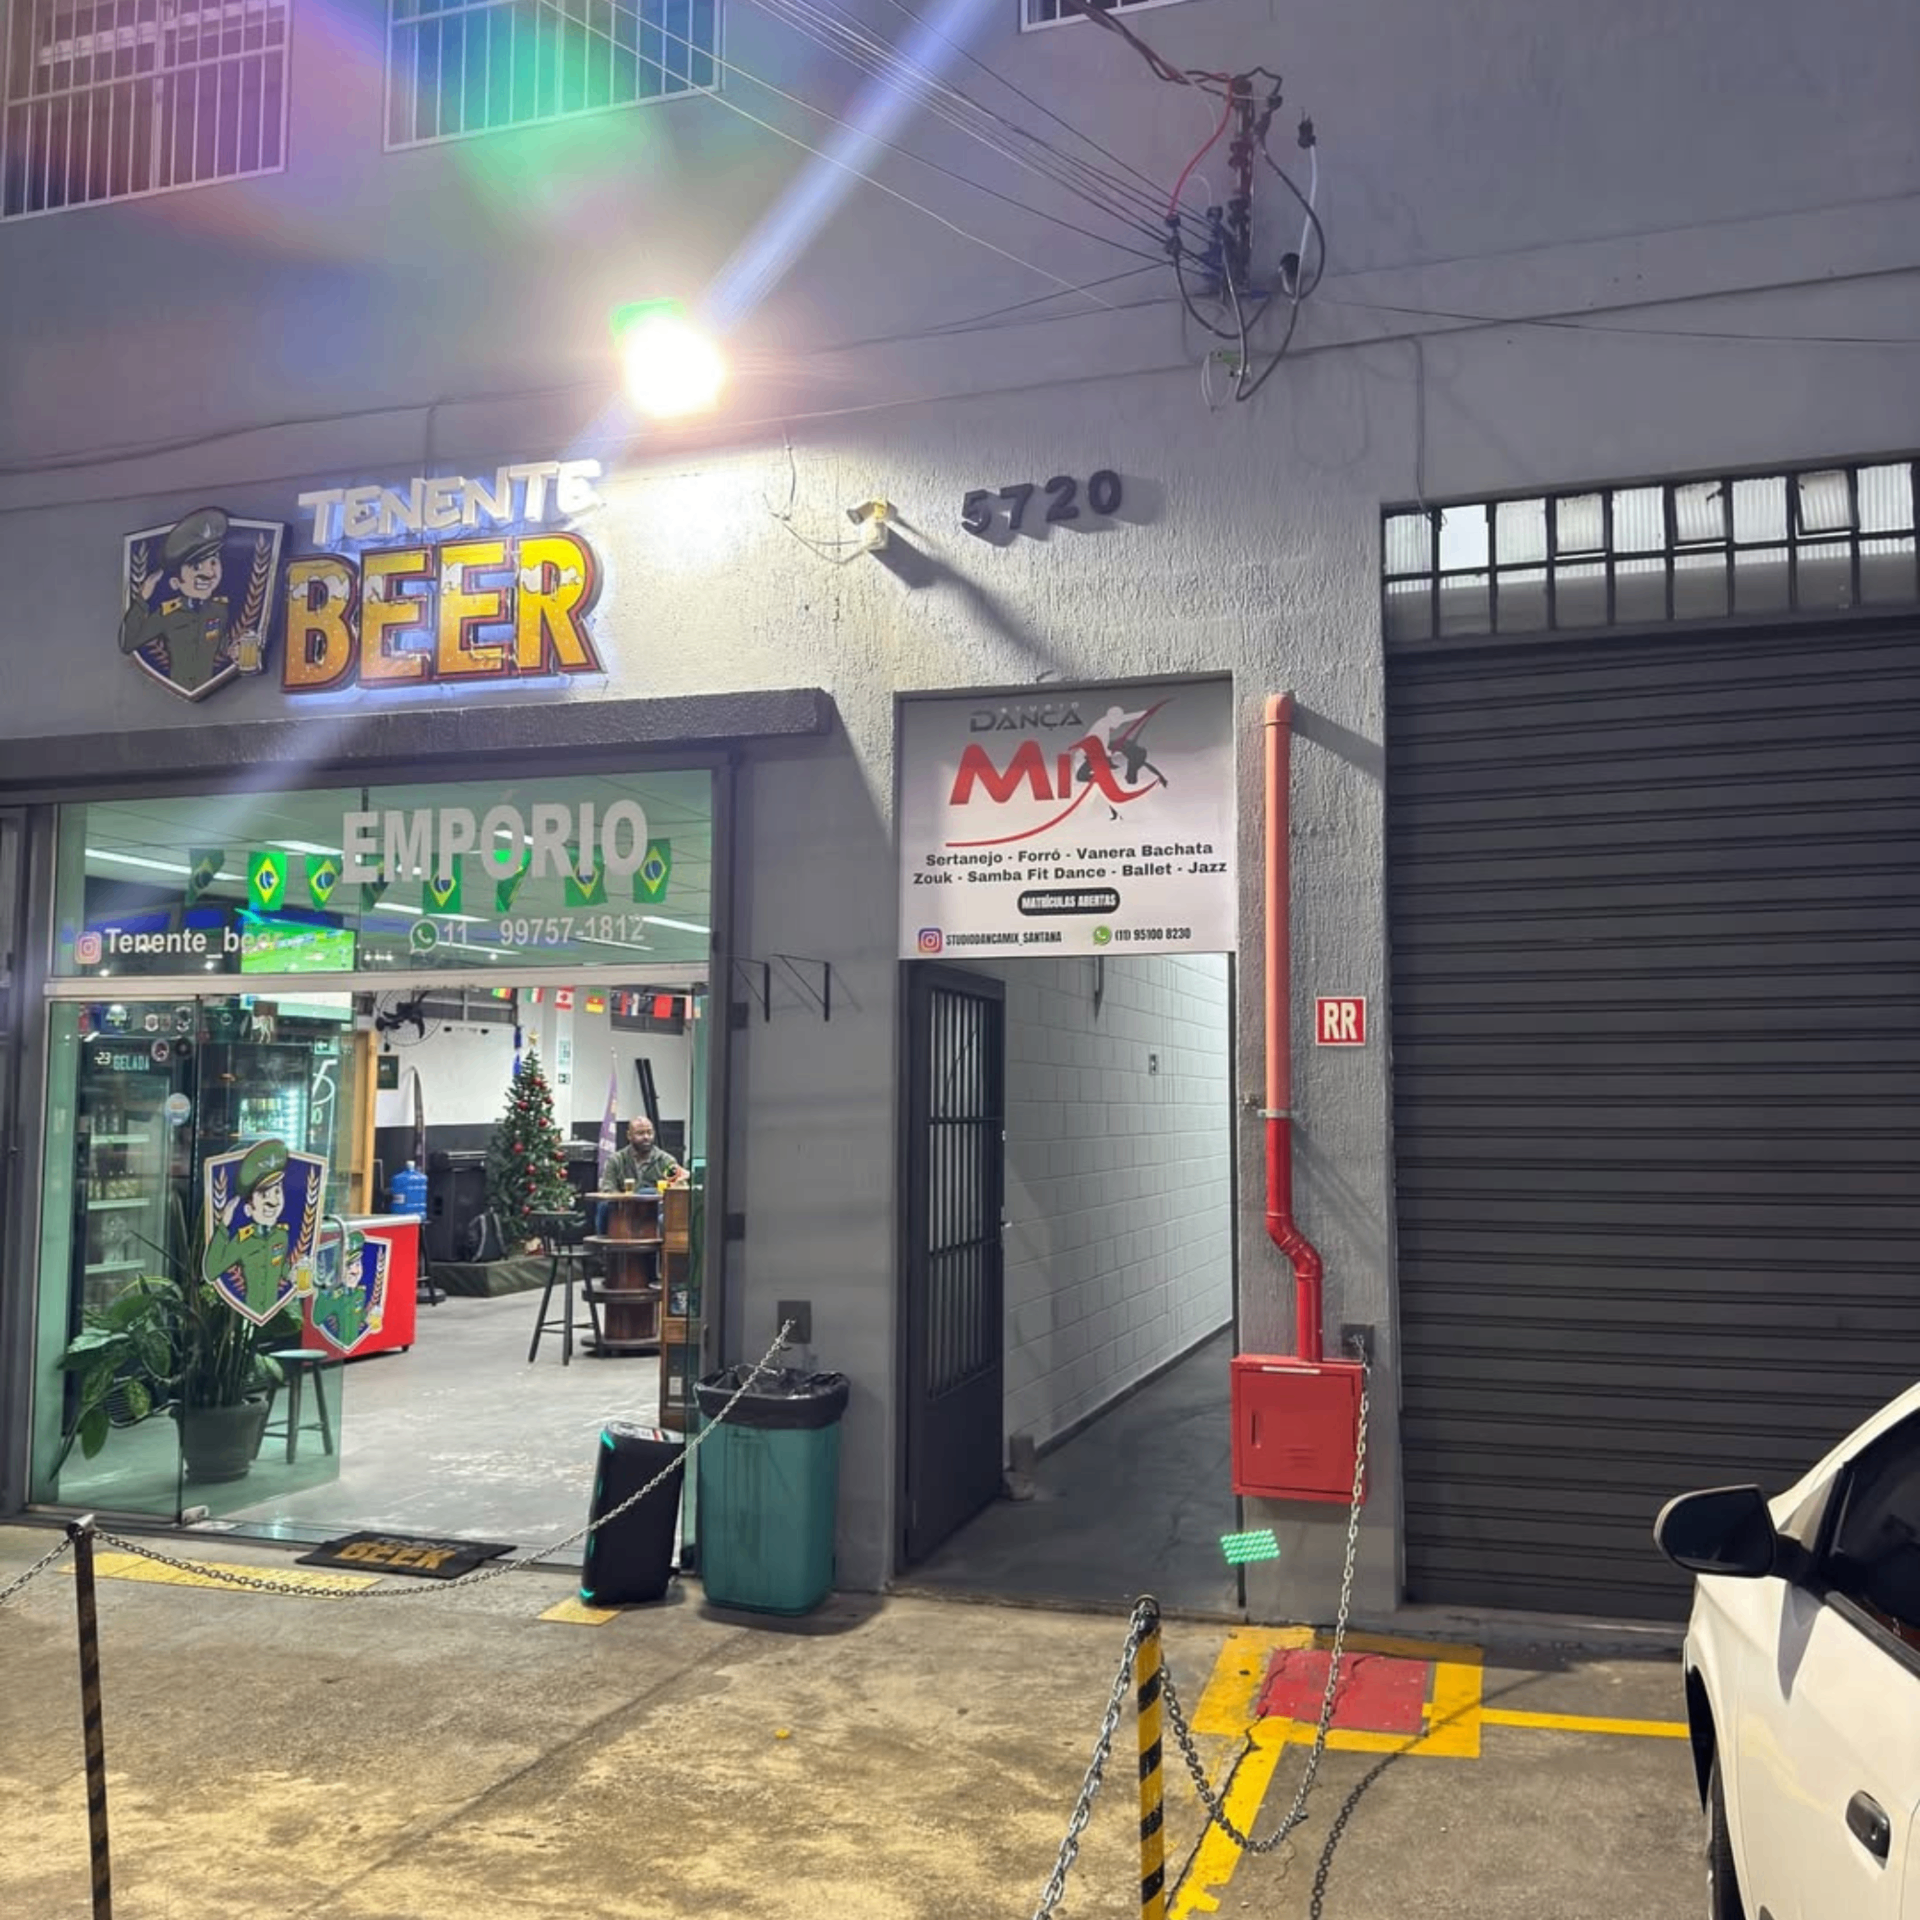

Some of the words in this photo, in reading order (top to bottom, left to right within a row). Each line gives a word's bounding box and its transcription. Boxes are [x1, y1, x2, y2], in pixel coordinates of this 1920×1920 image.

[299, 459, 602, 546] TENENTE
[961, 469, 1122, 535] 5720
[281, 532, 608, 693] BEER
[970, 709, 1084, 732] DANÇA
[926, 851, 1003, 867] Sertanejo
[1018, 848, 1061, 862] Forró
[1077, 847, 1136, 860] Vanera
[1142, 843, 1213, 857] Bachata
[913, 872, 953, 885] Zouk
[967, 869, 1022, 883] Samba
[1027, 867, 1049, 880] Fit
[1054, 867, 1106, 880] Dance
[1122, 863, 1172, 877] Ballet
[1188, 861, 1227, 874] Jazz
[105, 926, 284, 959] Tenente_beer
[443, 921, 468, 945] 11
[500, 914, 646, 945] 99757-1812
[1323, 1002, 1357, 1040] RR
